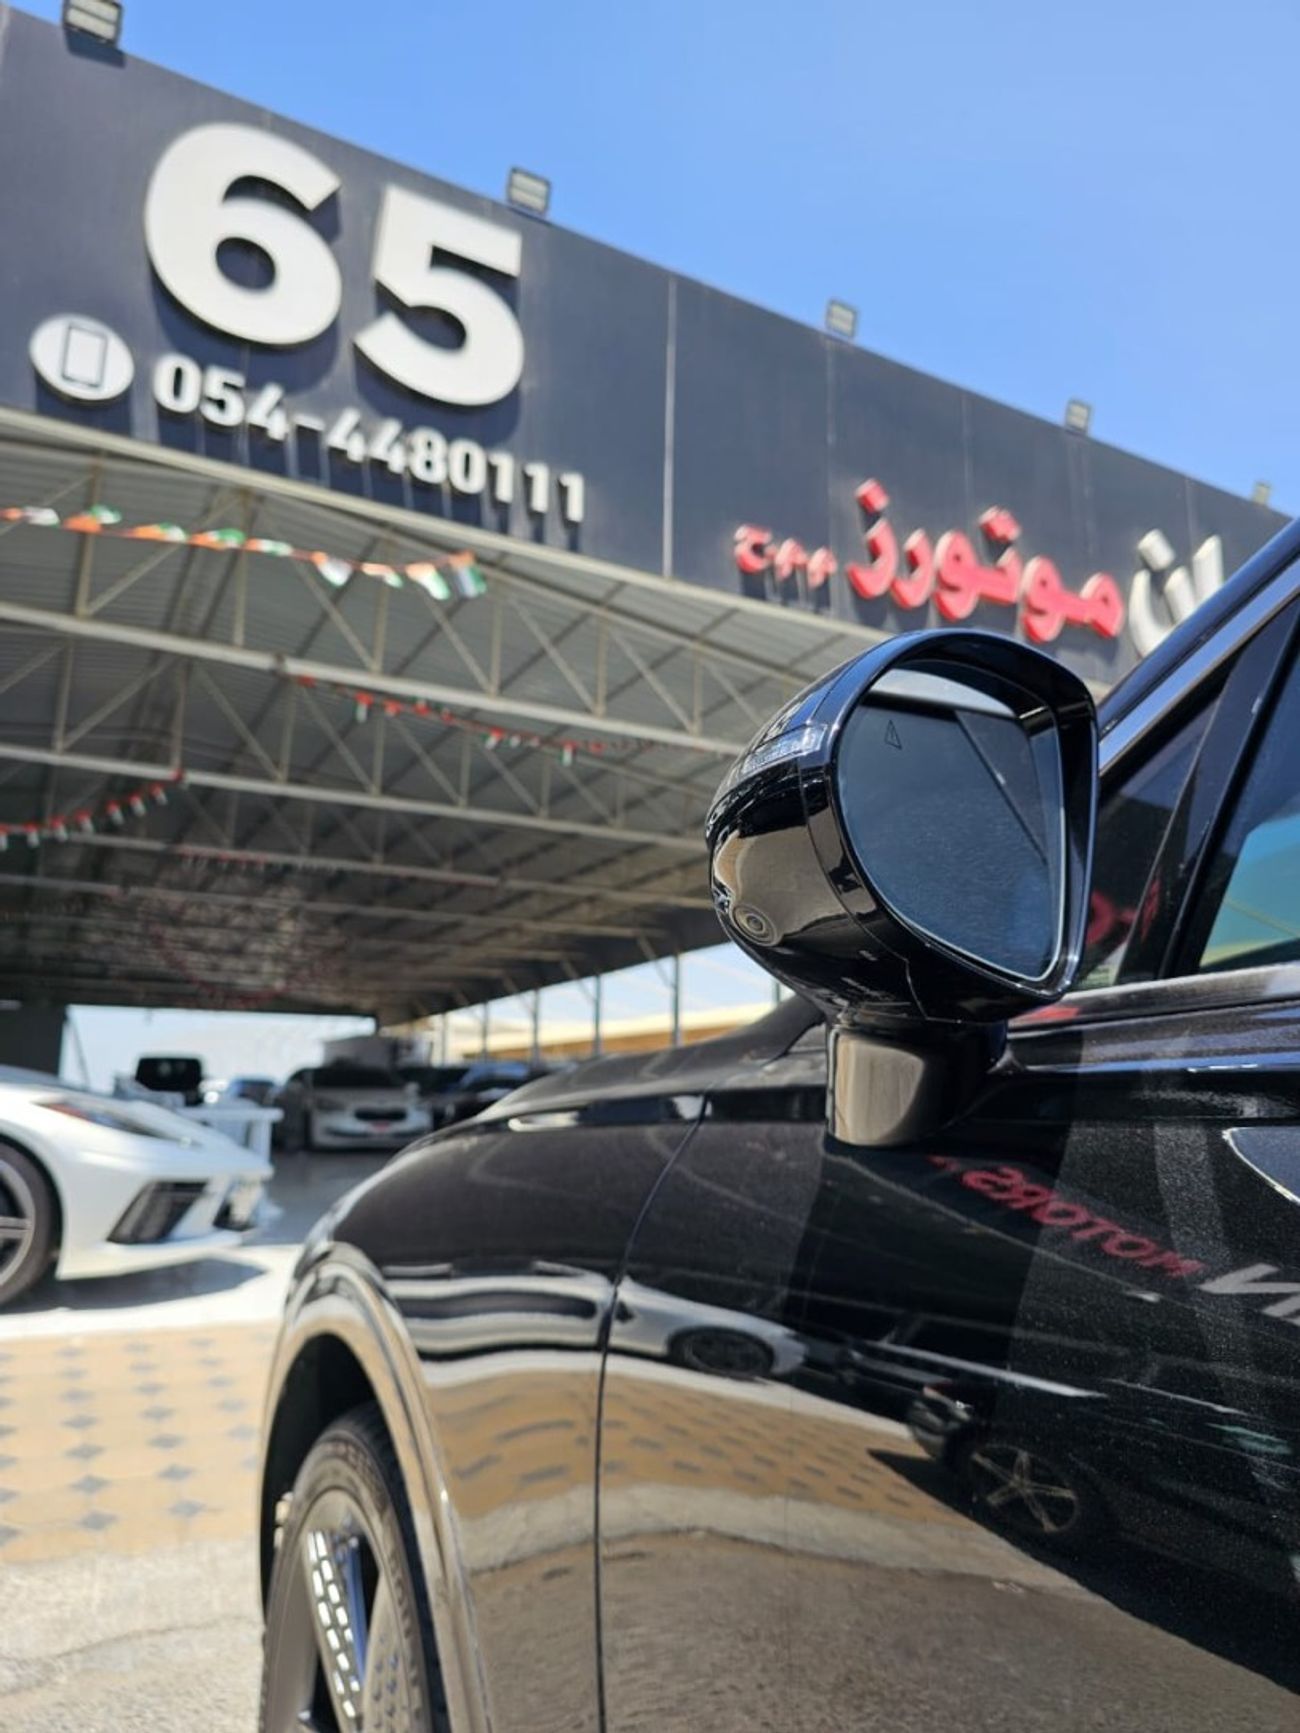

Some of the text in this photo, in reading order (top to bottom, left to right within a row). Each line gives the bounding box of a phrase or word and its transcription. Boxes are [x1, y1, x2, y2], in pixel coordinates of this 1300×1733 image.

[144, 122, 526, 406] 65
[152, 353, 585, 523] 054-4480111
[846, 478, 1124, 644] موتورز
